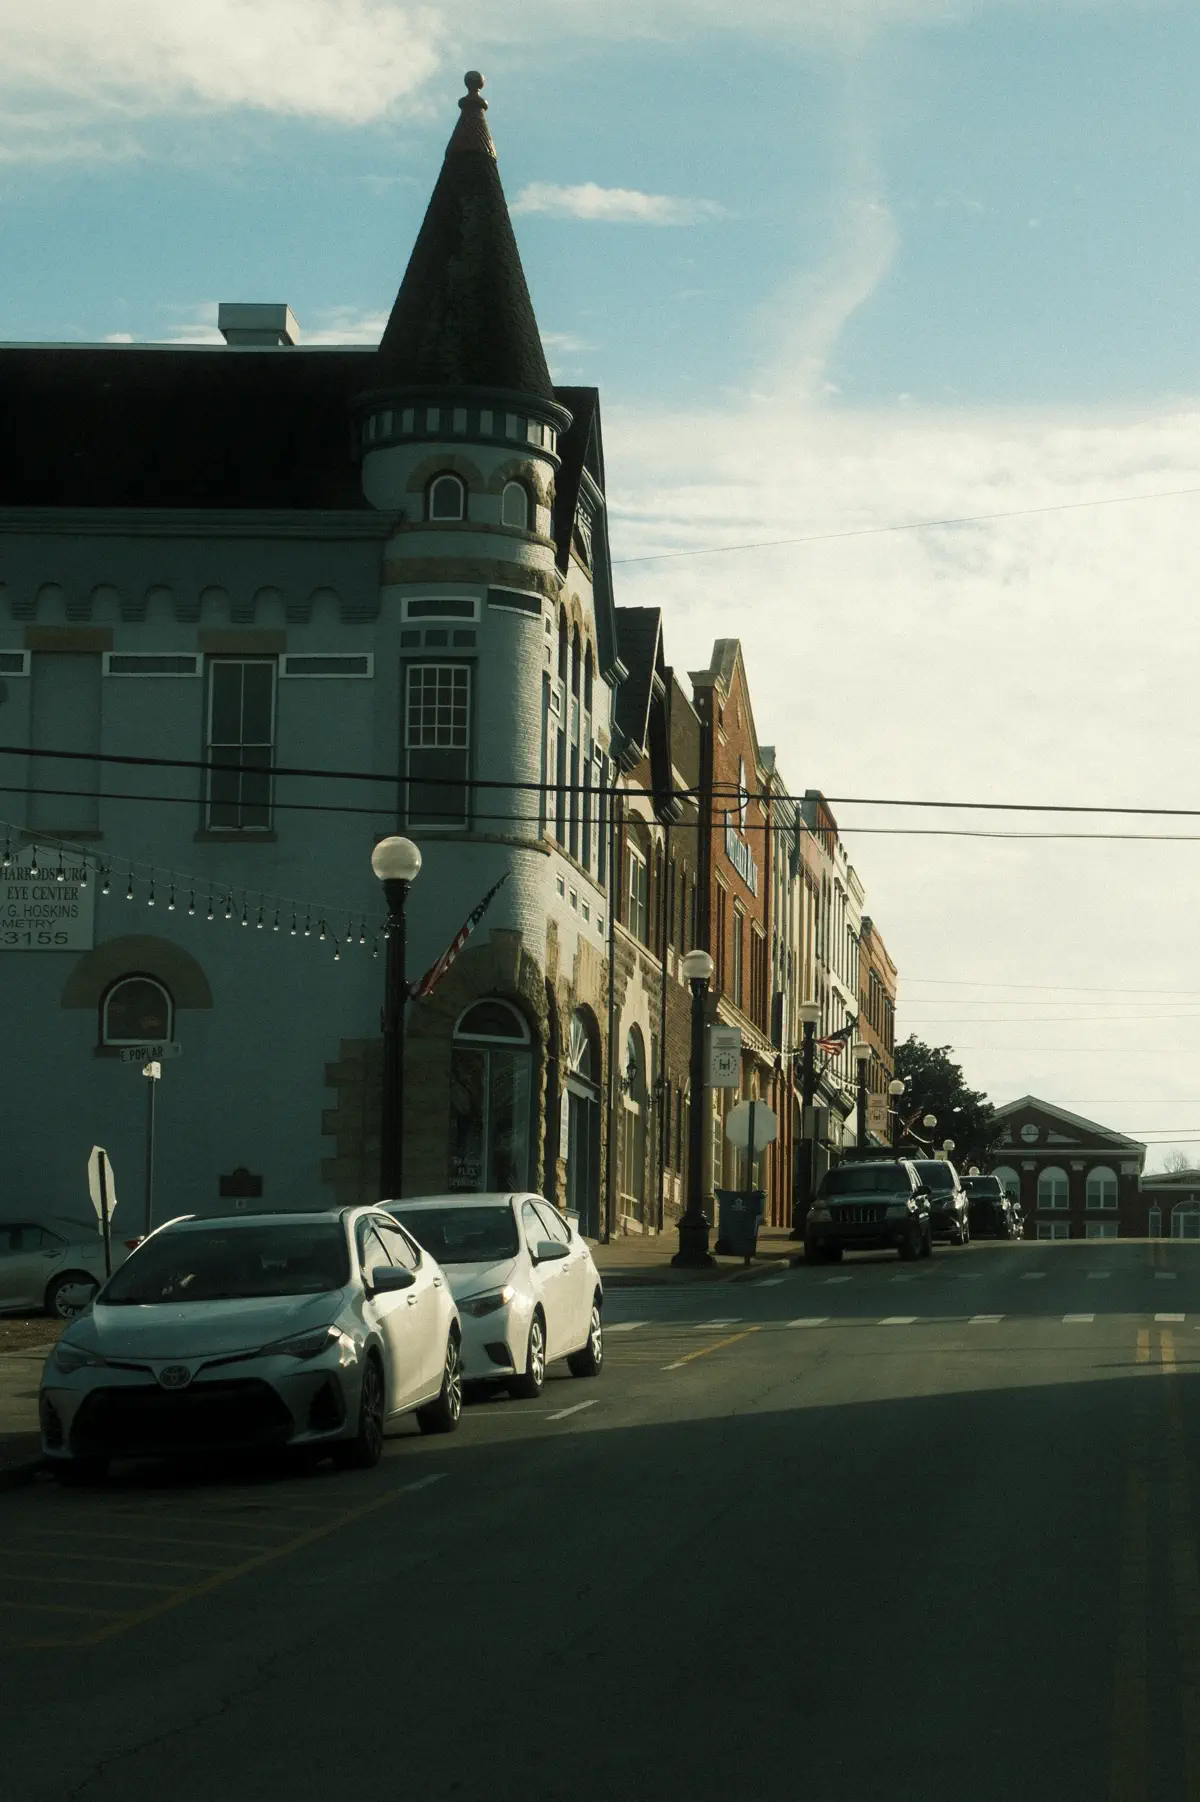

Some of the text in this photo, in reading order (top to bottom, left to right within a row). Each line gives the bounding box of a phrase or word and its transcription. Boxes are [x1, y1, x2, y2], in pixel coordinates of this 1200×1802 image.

[7, 886, 79, 900] EYE CENTER
[24, 904, 79, 918] HOSKINS
[0, 919, 56, 930] METRY
[129, 1046, 164, 1061] POPLAR
